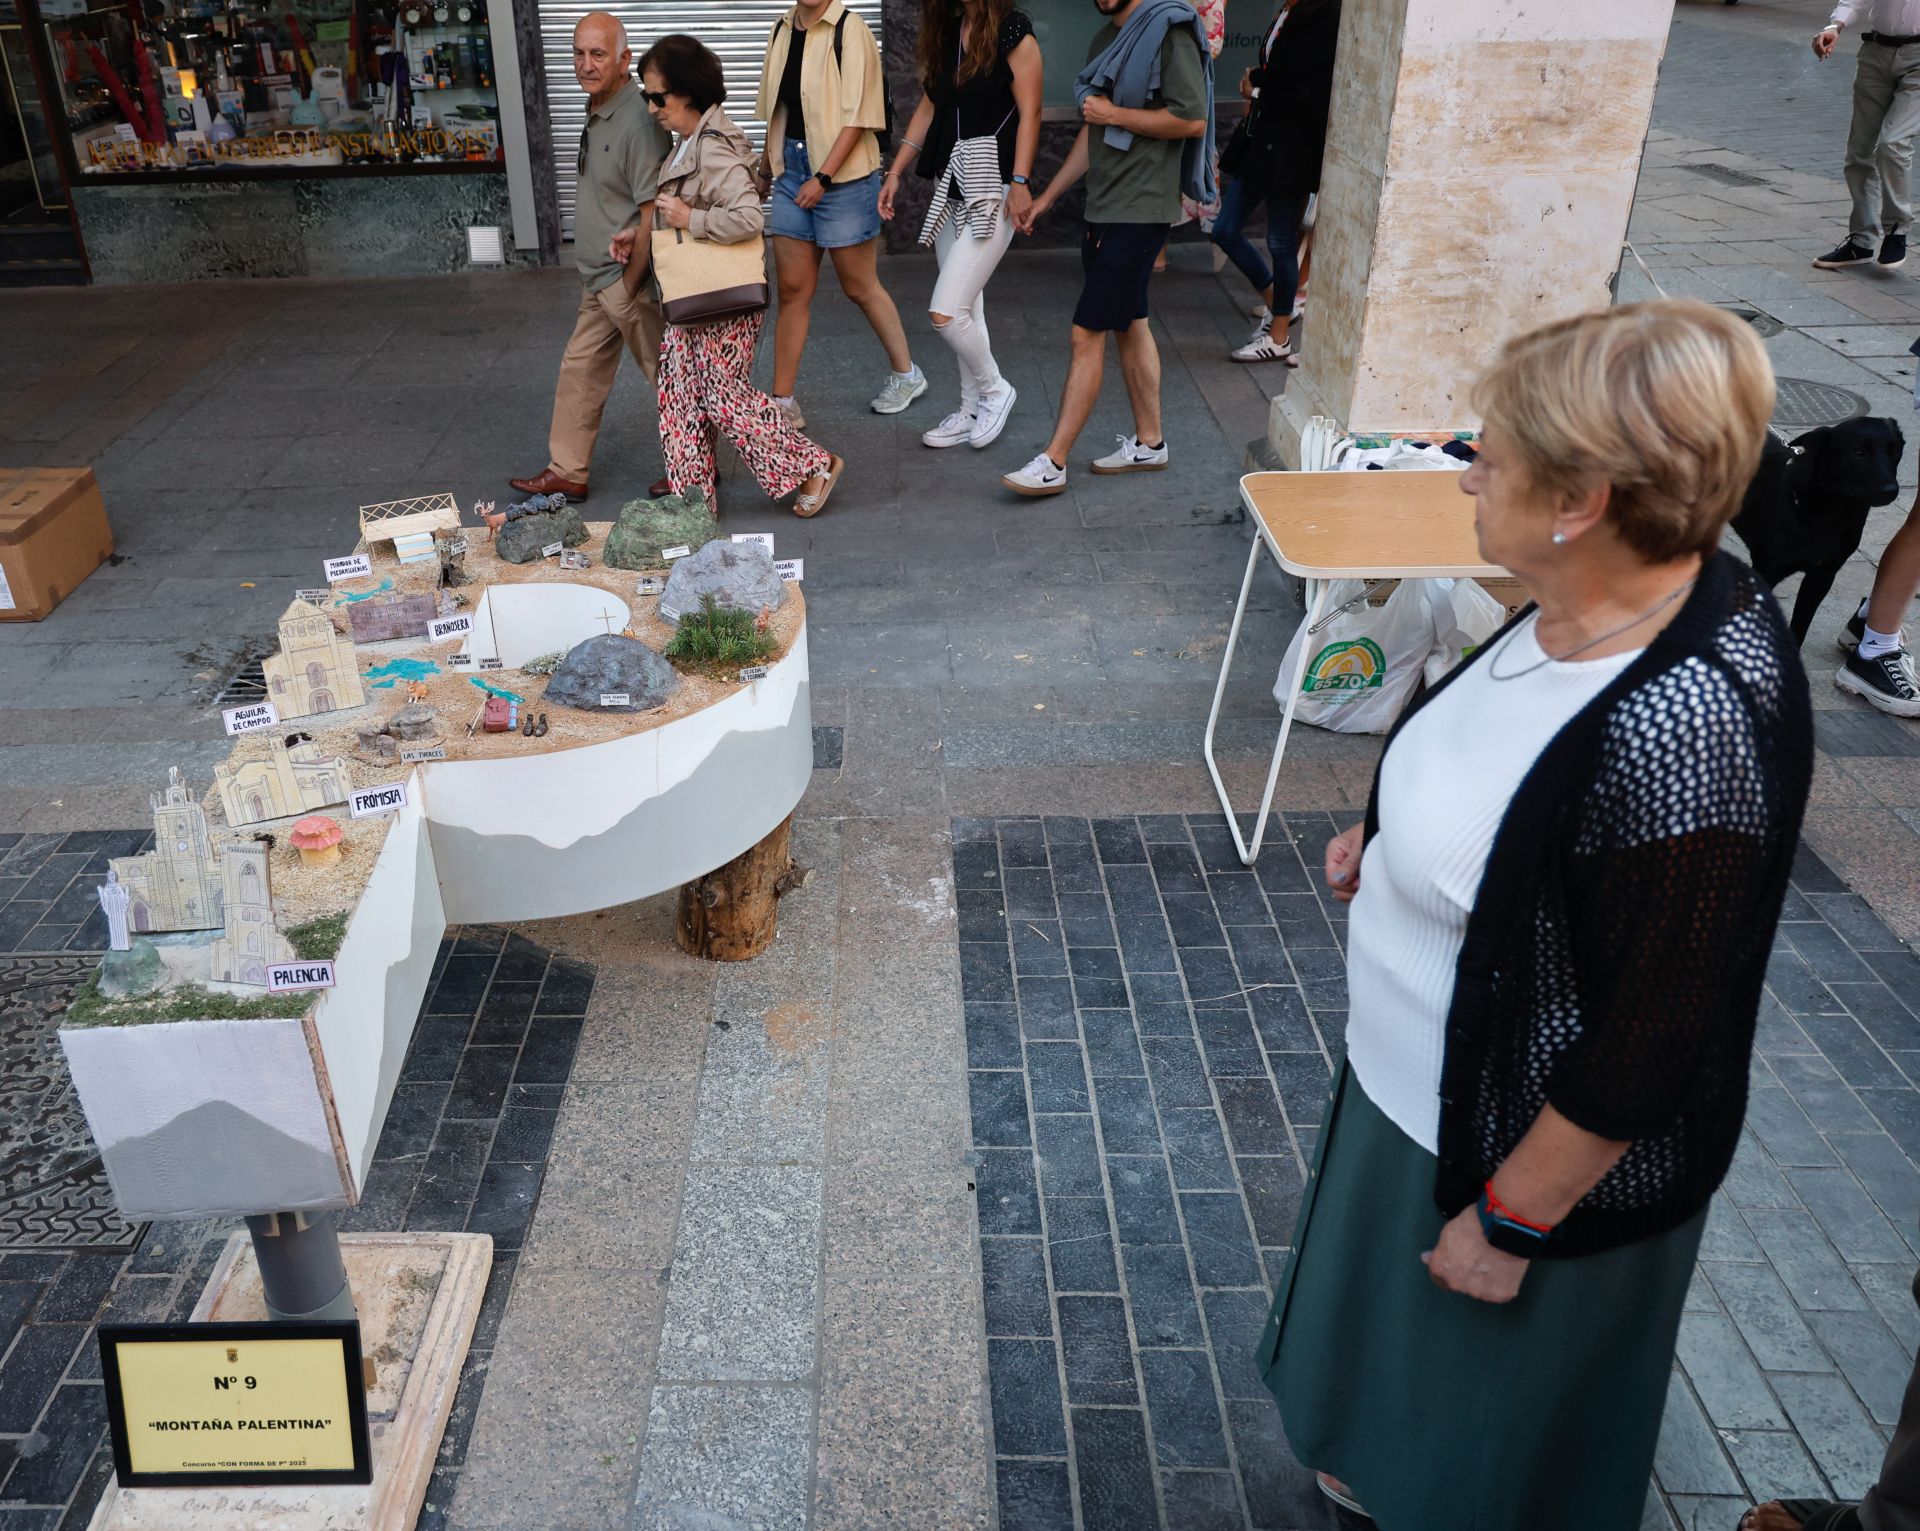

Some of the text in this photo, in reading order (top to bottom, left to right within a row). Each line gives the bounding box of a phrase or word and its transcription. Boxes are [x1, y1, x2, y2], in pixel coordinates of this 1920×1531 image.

[330, 560, 352, 569] MIRADOR
[774, 561, 795, 570] ARDAÑO
[434, 618, 470, 637] BRAÑOSERA
[235, 706, 268, 721] AGUILAR
[355, 789, 402, 811] FRÓMISTA
[273, 967, 330, 986] PALENCIA
[214, 1375, 257, 1390] Nº 9
[149, 1418, 332, 1432] “MONTAÑA PALENTINA”
